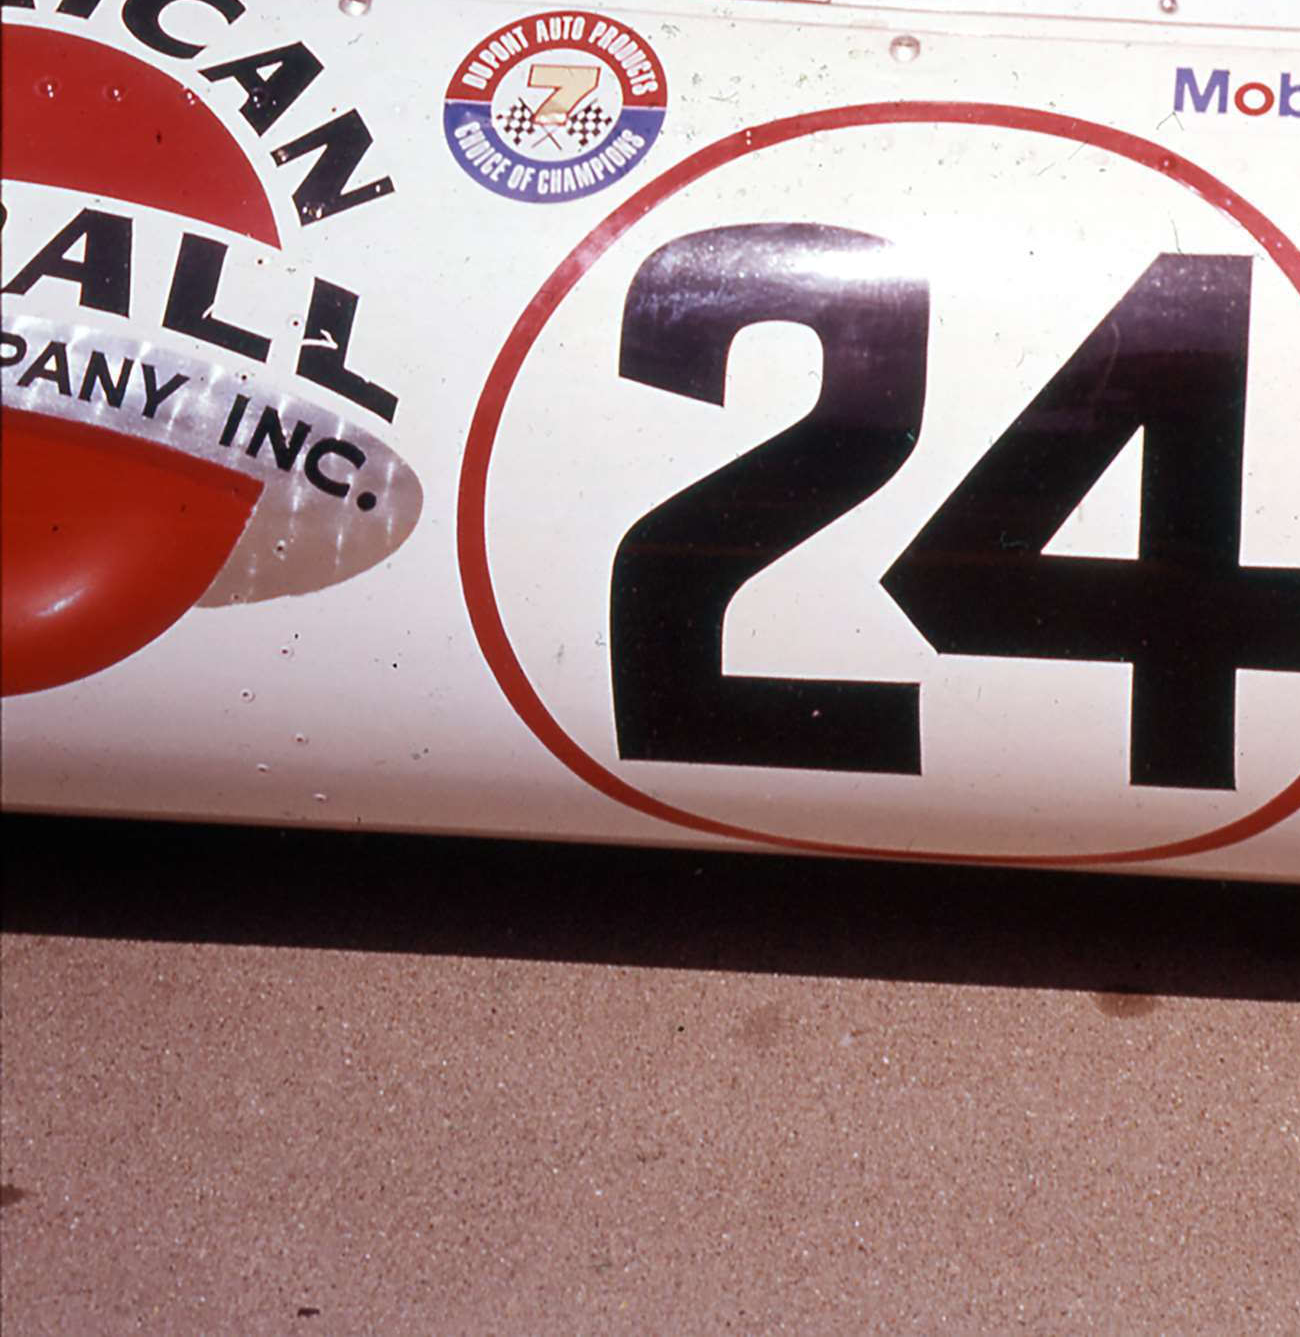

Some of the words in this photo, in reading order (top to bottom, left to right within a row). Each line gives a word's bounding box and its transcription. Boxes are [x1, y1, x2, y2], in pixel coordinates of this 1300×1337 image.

[527, 63, 602, 126] 7
[535, 16, 586, 43] AUTO
[588, 21, 659, 96] PRODUCTS
[454, 121, 512, 182] CHOICE
[506, 164, 537, 192] OF
[537, 129, 646, 195] CHAMPIONS
[0, 207, 399, 423] ALL
[218, 393, 377, 512] INC.
